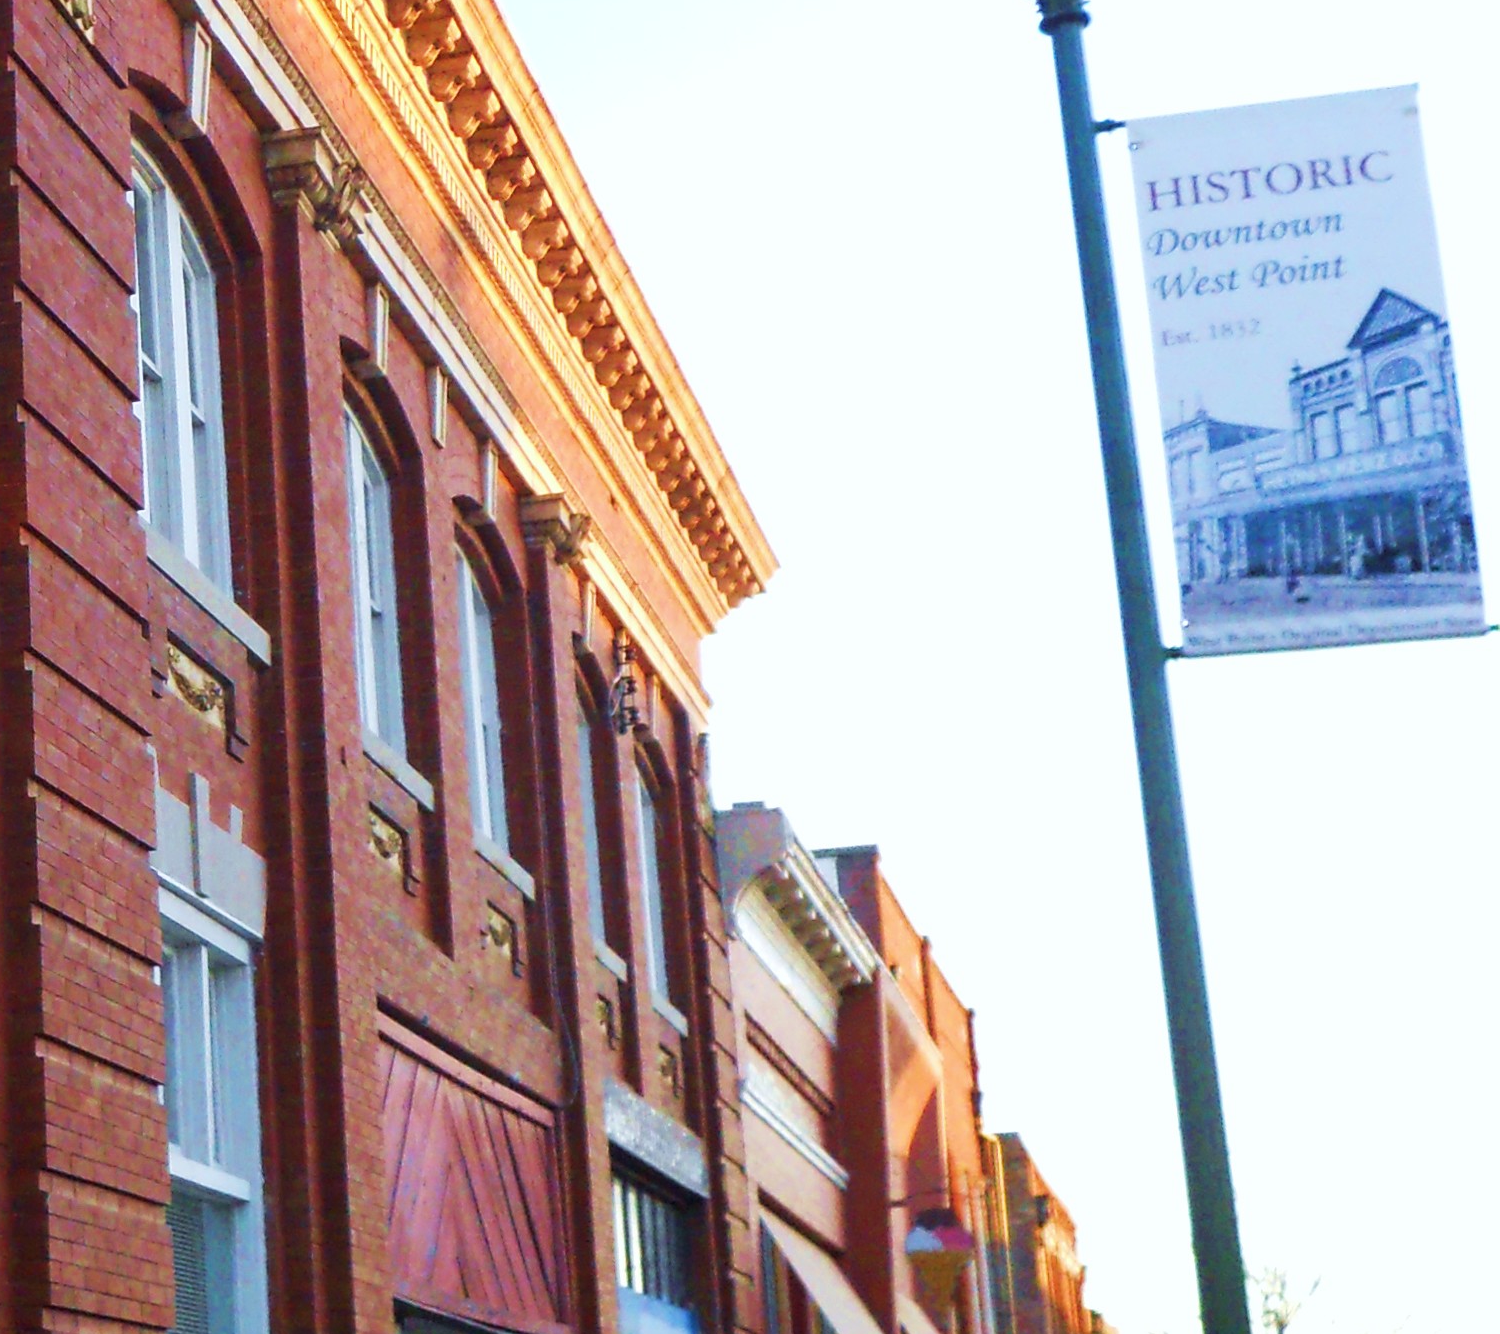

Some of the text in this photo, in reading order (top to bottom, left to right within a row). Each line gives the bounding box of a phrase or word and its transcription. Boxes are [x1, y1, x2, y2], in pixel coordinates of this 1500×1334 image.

[1146, 150, 1394, 212] HISTORIC
[1147, 213, 1344, 256] Downtown
[1153, 255, 1347, 300] West Point
[1162, 330, 1199, 347] Est.
